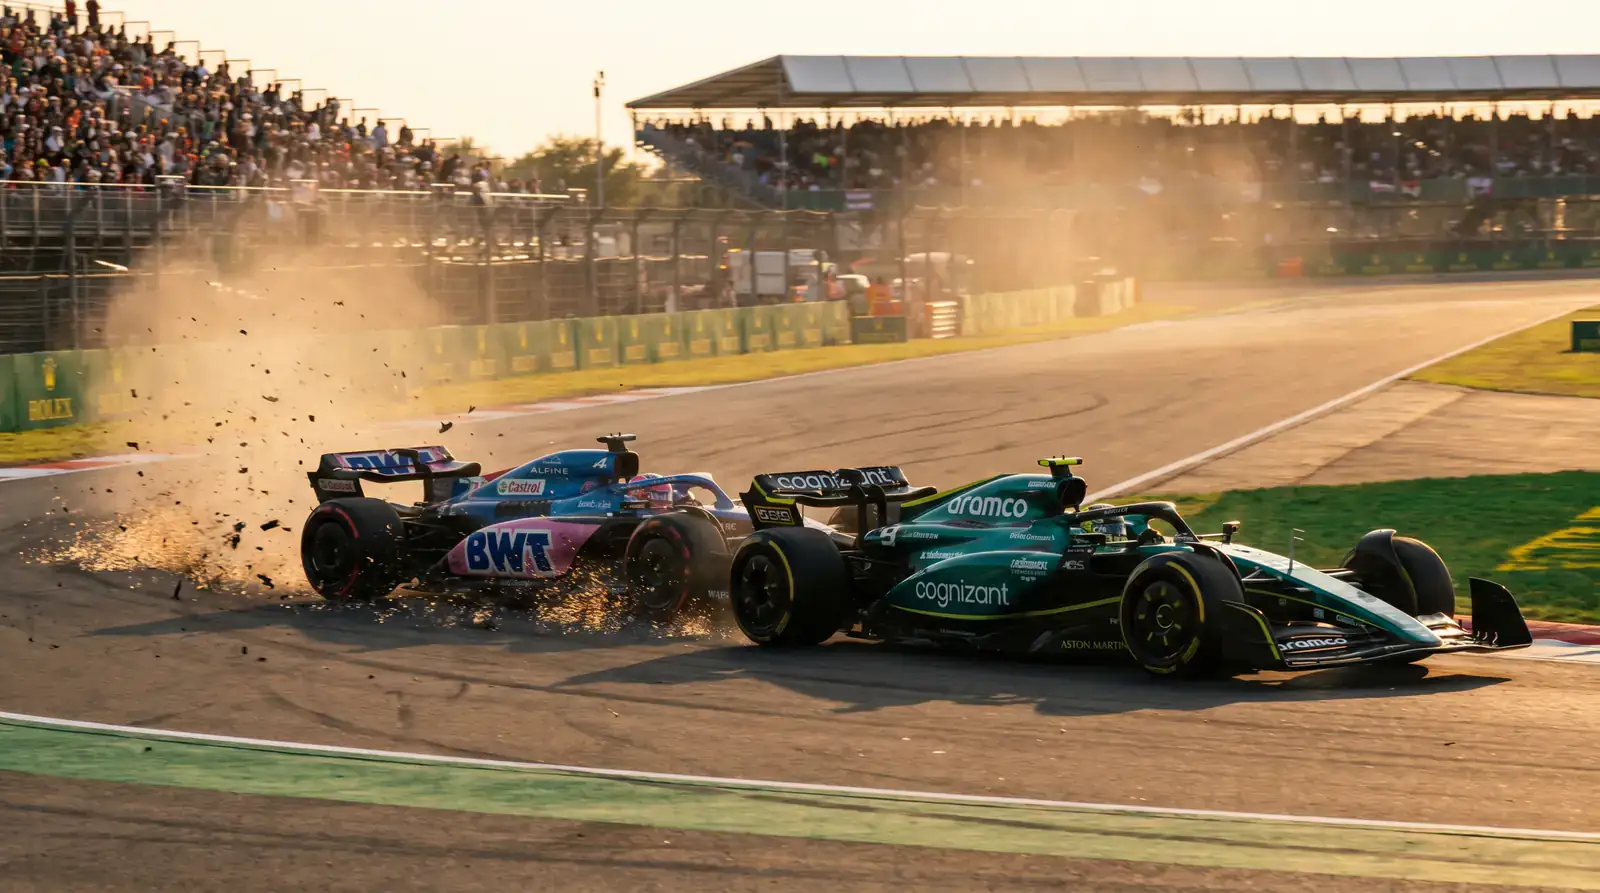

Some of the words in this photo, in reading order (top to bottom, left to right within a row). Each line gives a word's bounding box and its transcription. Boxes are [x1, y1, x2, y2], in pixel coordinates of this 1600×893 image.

[530, 466, 569, 475] ALPINE
[507, 480, 543, 494] Castrol
[947, 496, 1029, 518] aramco
[466, 530, 553, 573] BWT
[915, 579, 1010, 608] cognizant
[1060, 640, 1091, 650] ASTON
[1277, 637, 1348, 651] aramco
